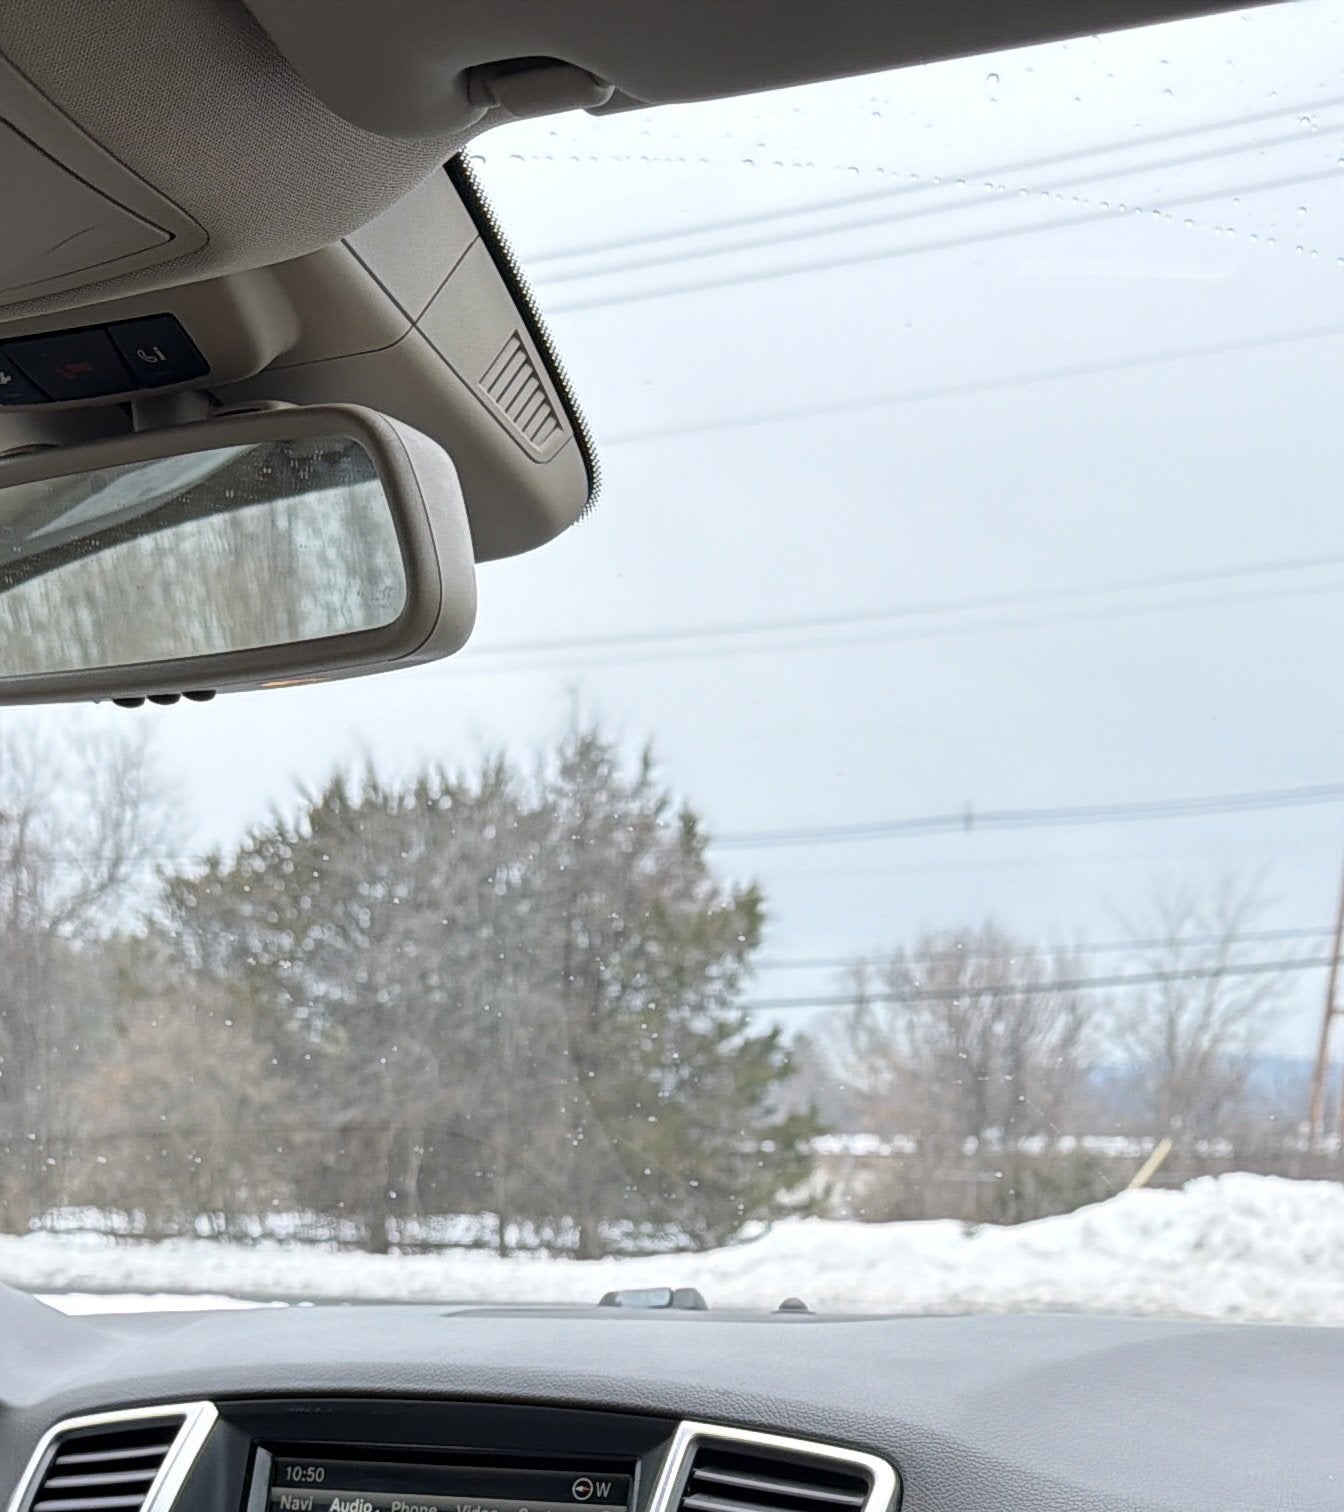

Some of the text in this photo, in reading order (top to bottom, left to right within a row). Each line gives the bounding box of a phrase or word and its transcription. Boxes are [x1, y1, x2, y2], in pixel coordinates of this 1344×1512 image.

[285, 1466, 325, 1483] 10:50
[595, 1481, 611, 1498] W
[279, 1495, 314, 1512] Navi
